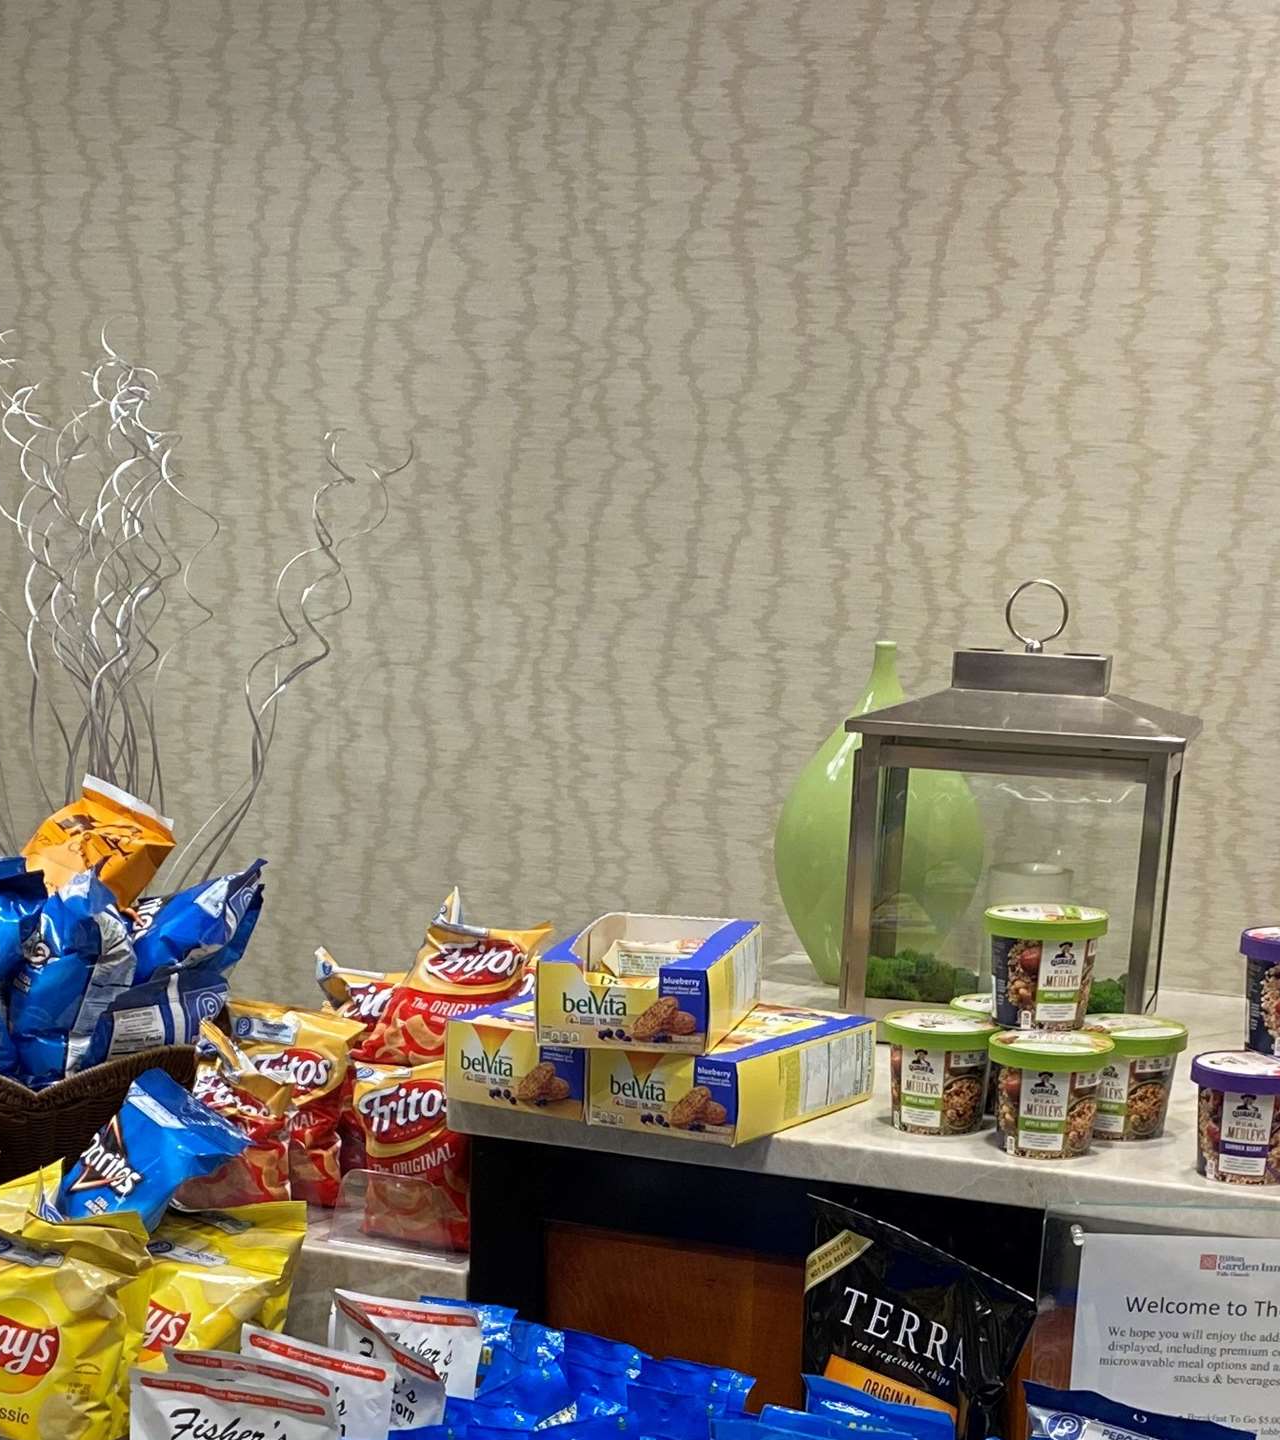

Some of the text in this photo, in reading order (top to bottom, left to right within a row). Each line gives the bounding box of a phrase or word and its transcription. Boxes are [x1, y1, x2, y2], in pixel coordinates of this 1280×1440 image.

[424, 939, 525, 982] Fritos
[1051, 957, 1076, 967] QUAKER
[663, 976, 700, 987] blueberry
[1043, 975, 1080, 988] MEDLEYS
[562, 988, 627, 1017] belVita
[460, 1048, 513, 1077] belVita
[908, 1064, 934, 1074] QUAKER
[697, 1066, 731, 1078] blueberry
[610, 1073, 666, 1102] belVita
[904, 1079, 940, 1096] MEDLEYS
[359, 1083, 446, 1133] Fritos
[1023, 1103, 1063, 1117] MEDLEYS
[1126, 1296, 1220, 1316] Welcome
[1227, 1301, 1248, 1318] to
[840, 1286, 966, 1378] TERRA
[1108, 1326, 1126, 1338] We
[1129, 1328, 1156, 1341] hope
[1159, 1330, 1179, 1342] you
[1182, 1329, 1204, 1340] will
[1206, 1330, 1236, 1343] enjoy
[1240, 1331, 1257, 1342] the
[1108, 1342, 1162, 1355] displayed,
[1166, 1344, 1216, 1357] including
[1220, 1346, 1268, 1359] premium
[851, 1339, 950, 1386] real vegetable chips
[1100, 1356, 1174, 1368] microwavable
[1178, 1358, 1204, 1369] meal
[1207, 1360, 1247, 1373] options
[1250, 1361, 1269, 1372] and
[1174, 1373, 1210, 1384] snacks
